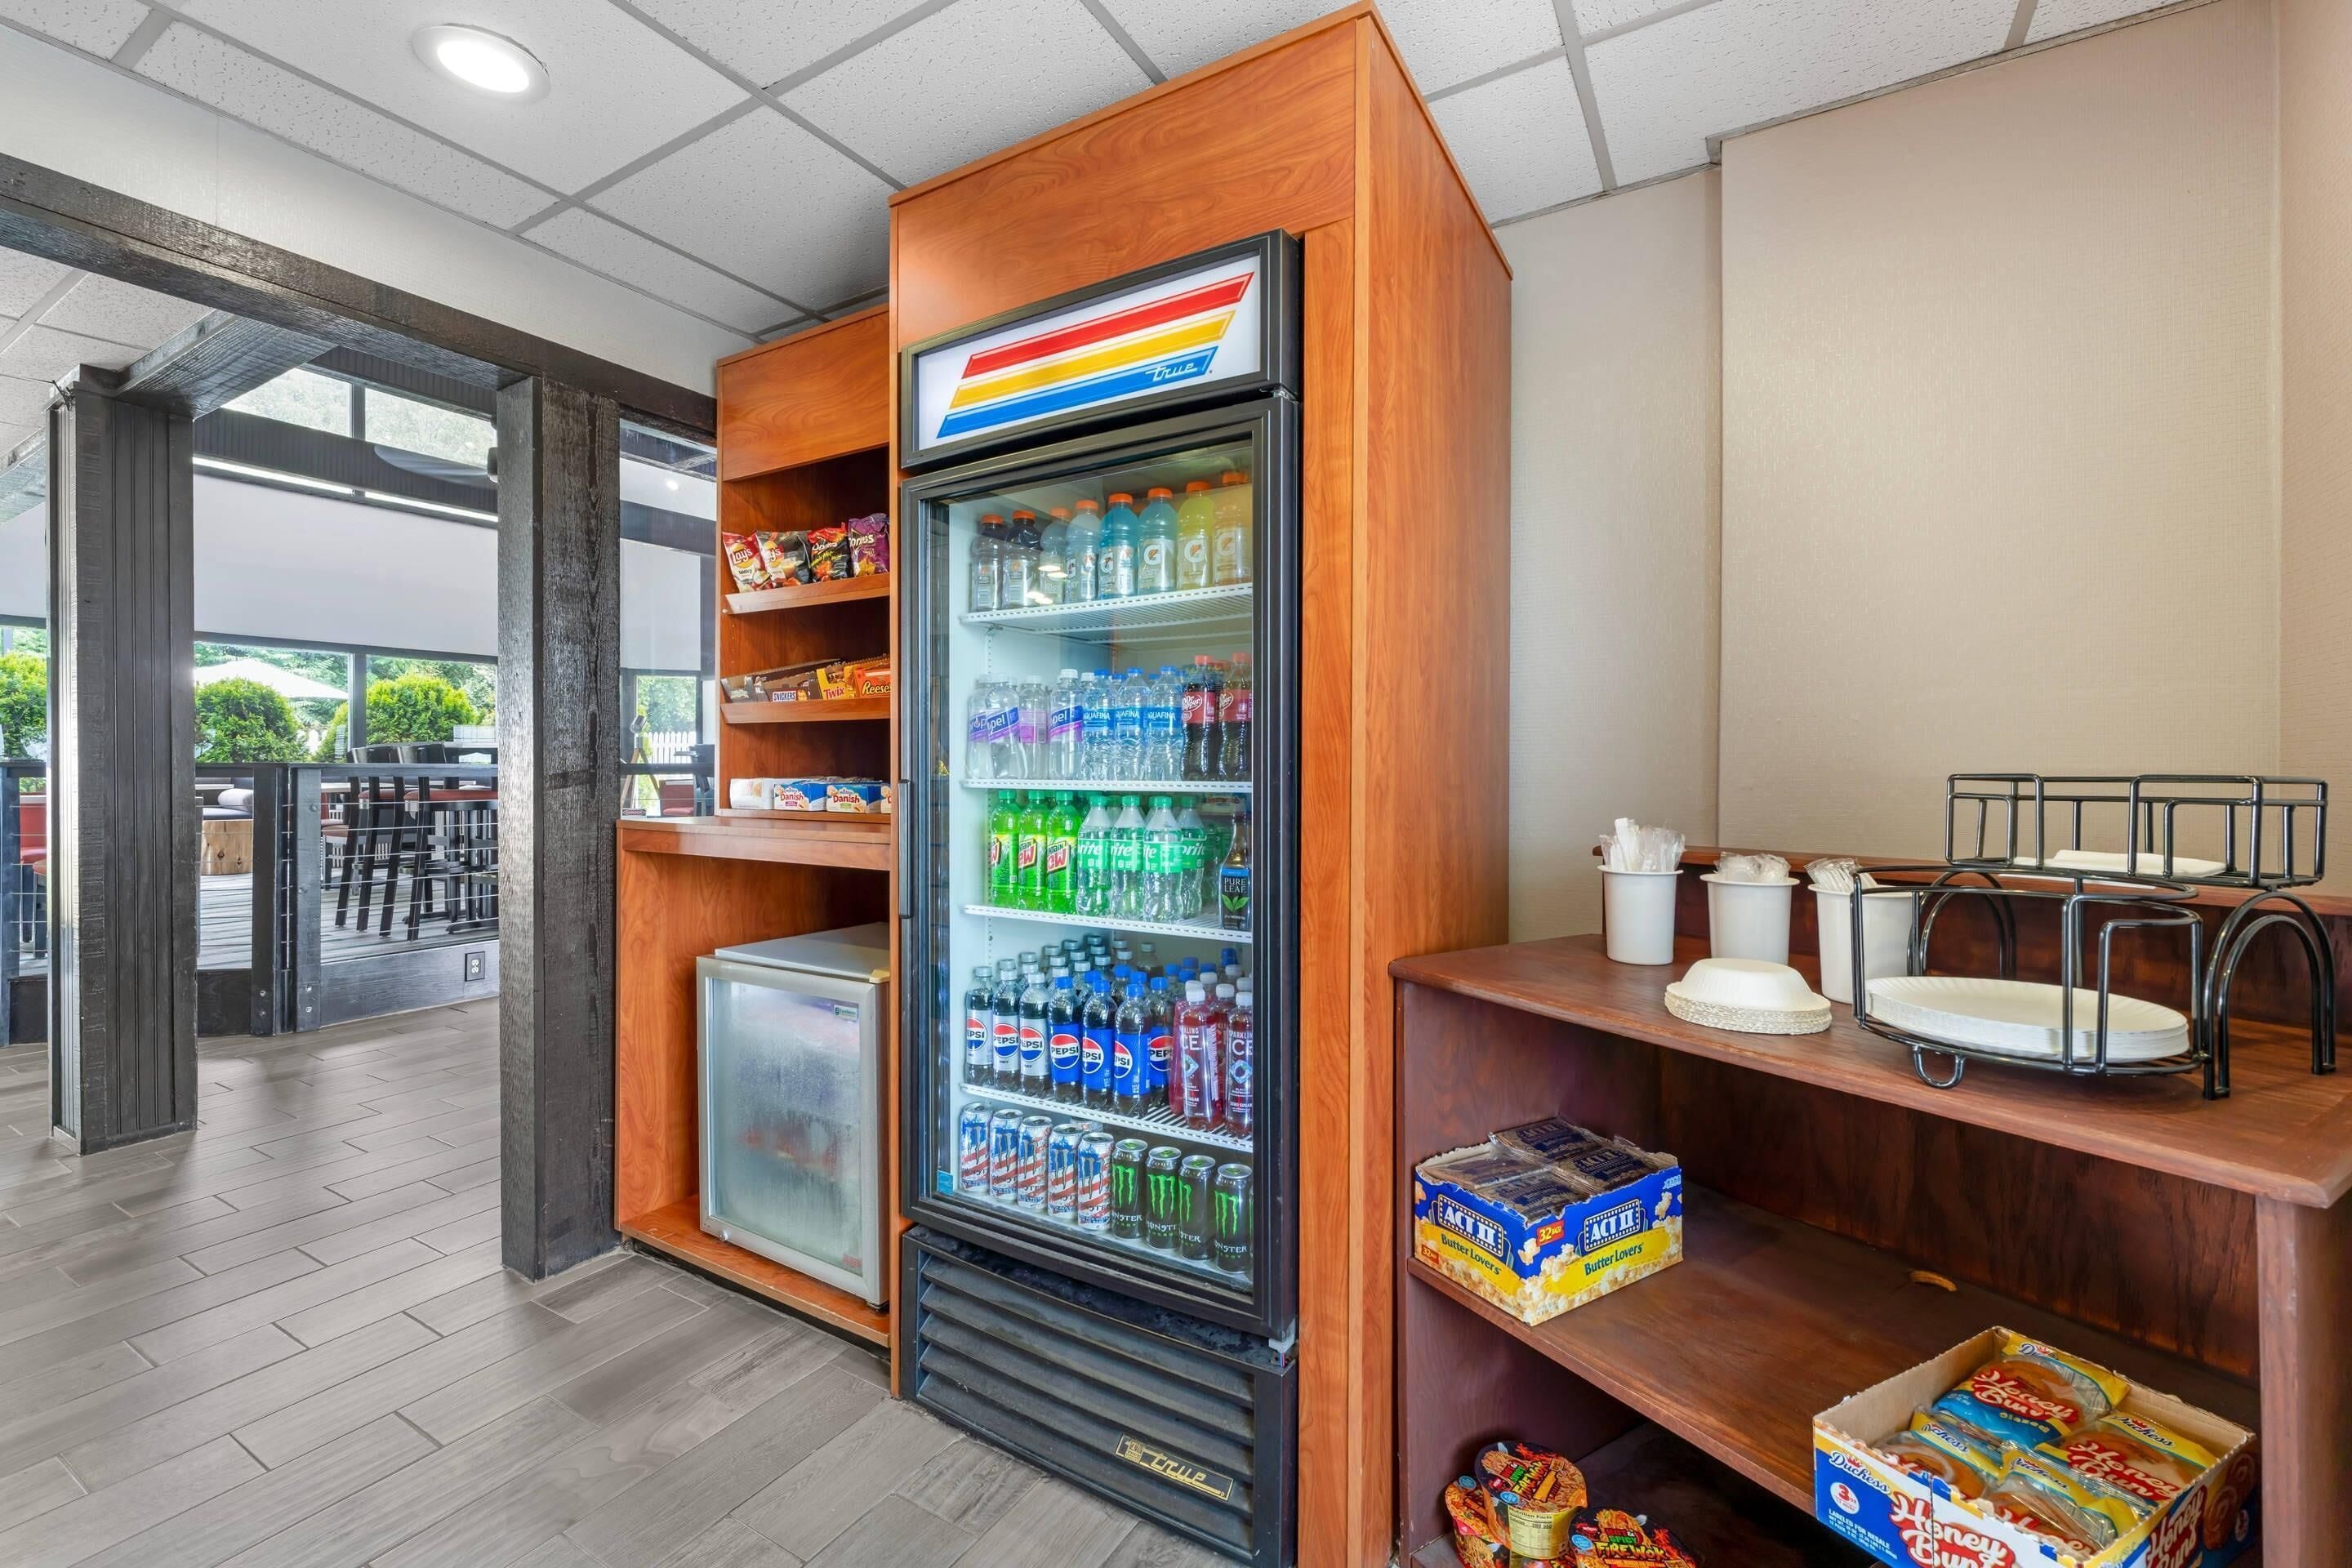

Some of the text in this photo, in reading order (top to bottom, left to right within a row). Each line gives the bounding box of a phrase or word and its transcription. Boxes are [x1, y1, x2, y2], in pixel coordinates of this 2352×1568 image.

[732, 547, 753, 565] Lay's
[773, 692, 795, 701] SNICKERS
[823, 687, 844, 700] Twix
[780, 792, 804, 801] Danish
[833, 795, 860, 804] Danish
[1224, 877, 1246, 886] PURE
[1224, 885, 1246, 893] LEAF
[994, 1036, 1018, 1045] PEPSI
[1051, 1046, 1079, 1055] PEPSI
[1444, 1205, 1496, 1246] ACT II
[1539, 1227, 1552, 1242] 32
[1590, 1208, 1635, 1243] ACT II
[1441, 1233, 1501, 1275] Butter Lovers
[1584, 1243, 1644, 1276] Butter Lovers
[1973, 1370, 2074, 1421] Honey
[1975, 1384, 2043, 1416] Bun
[1830, 1451, 1890, 1493] Duchess
[1838, 1484, 1850, 1501] 3
[1829, 1508, 1854, 1527] LABELED
[1854, 1522, 1867, 1535] FOR
[1867, 1531, 1891, 1550] RESALE
[1890, 1492, 2007, 1566] Honey
[2147, 1488, 2204, 1561] Honey
[1608, 1535, 1637, 1544] SPICY
[1902, 1529, 1980, 1568] Bun
